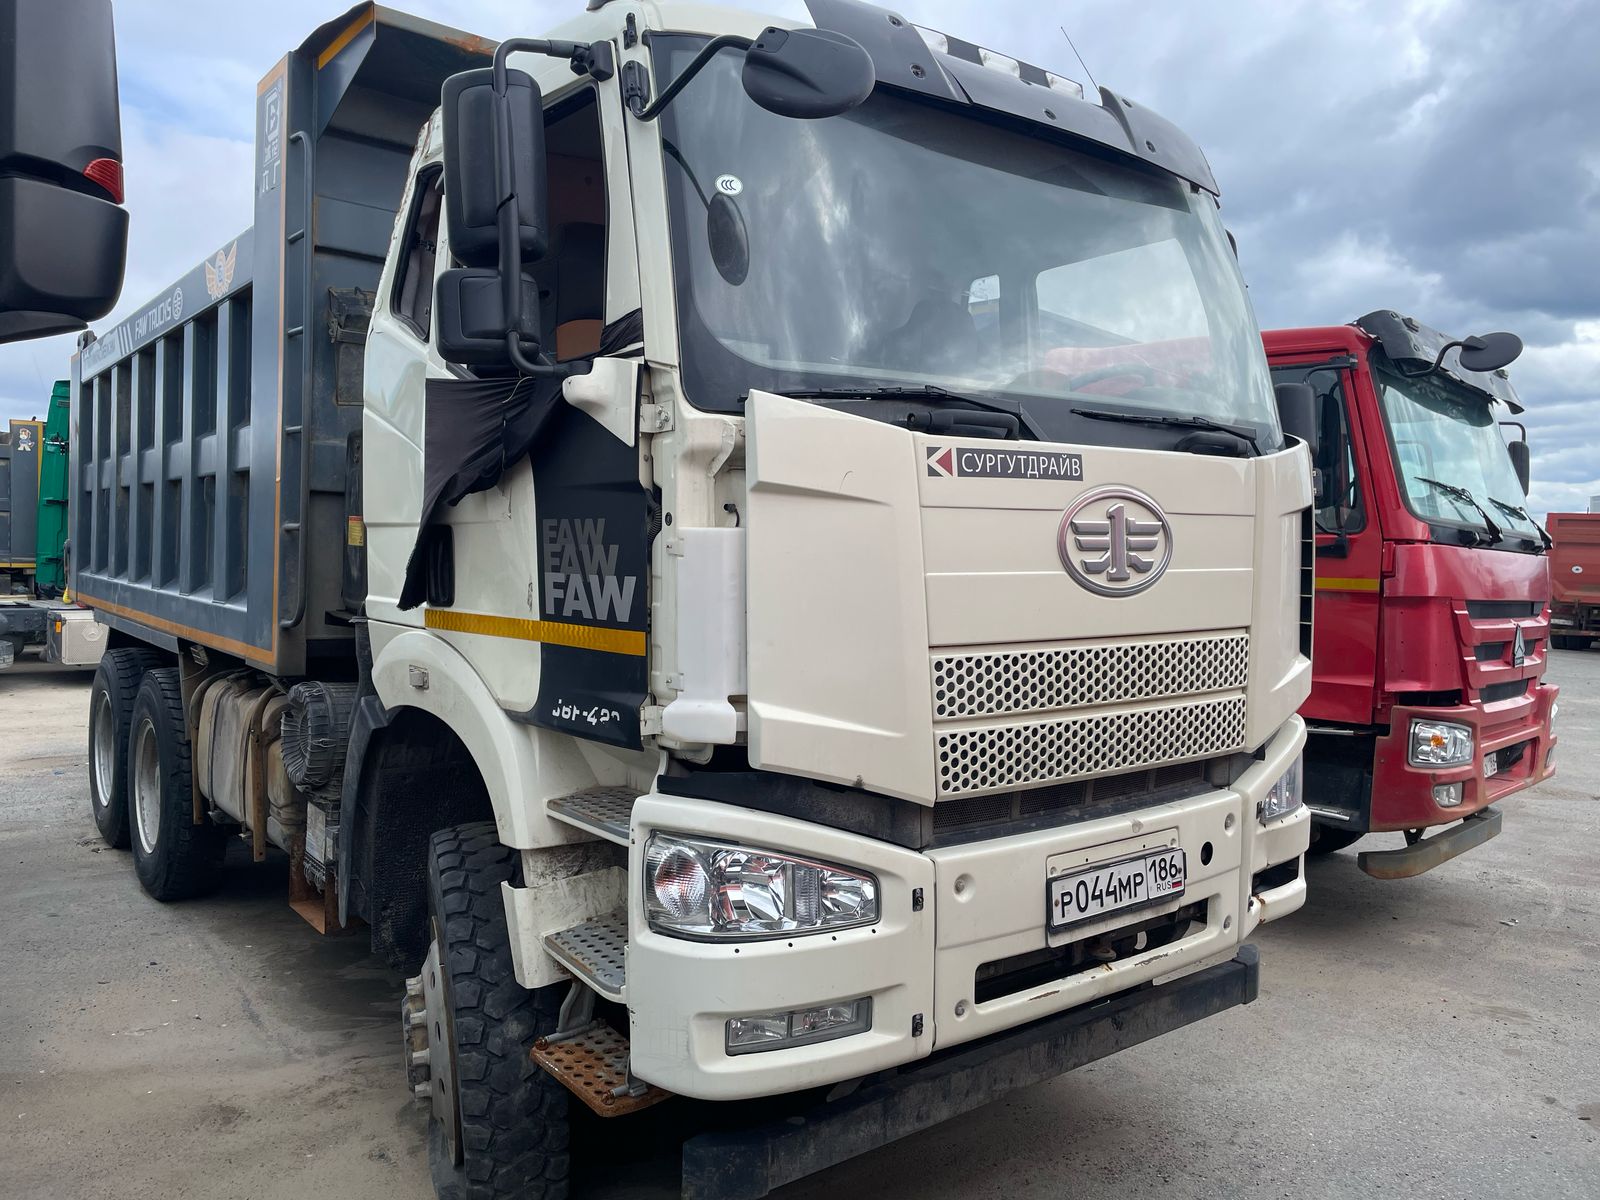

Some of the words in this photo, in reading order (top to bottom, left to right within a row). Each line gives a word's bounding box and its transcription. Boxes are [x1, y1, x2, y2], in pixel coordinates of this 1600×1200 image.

[961, 453, 1081, 478] СУРГУТДРАЙВ
[542, 518, 606, 546] FAW
[543, 544, 620, 582] FAW
[544, 572, 637, 623] FAW
[1149, 855, 1178, 884] 186
[1156, 880, 1172, 892] RUS
